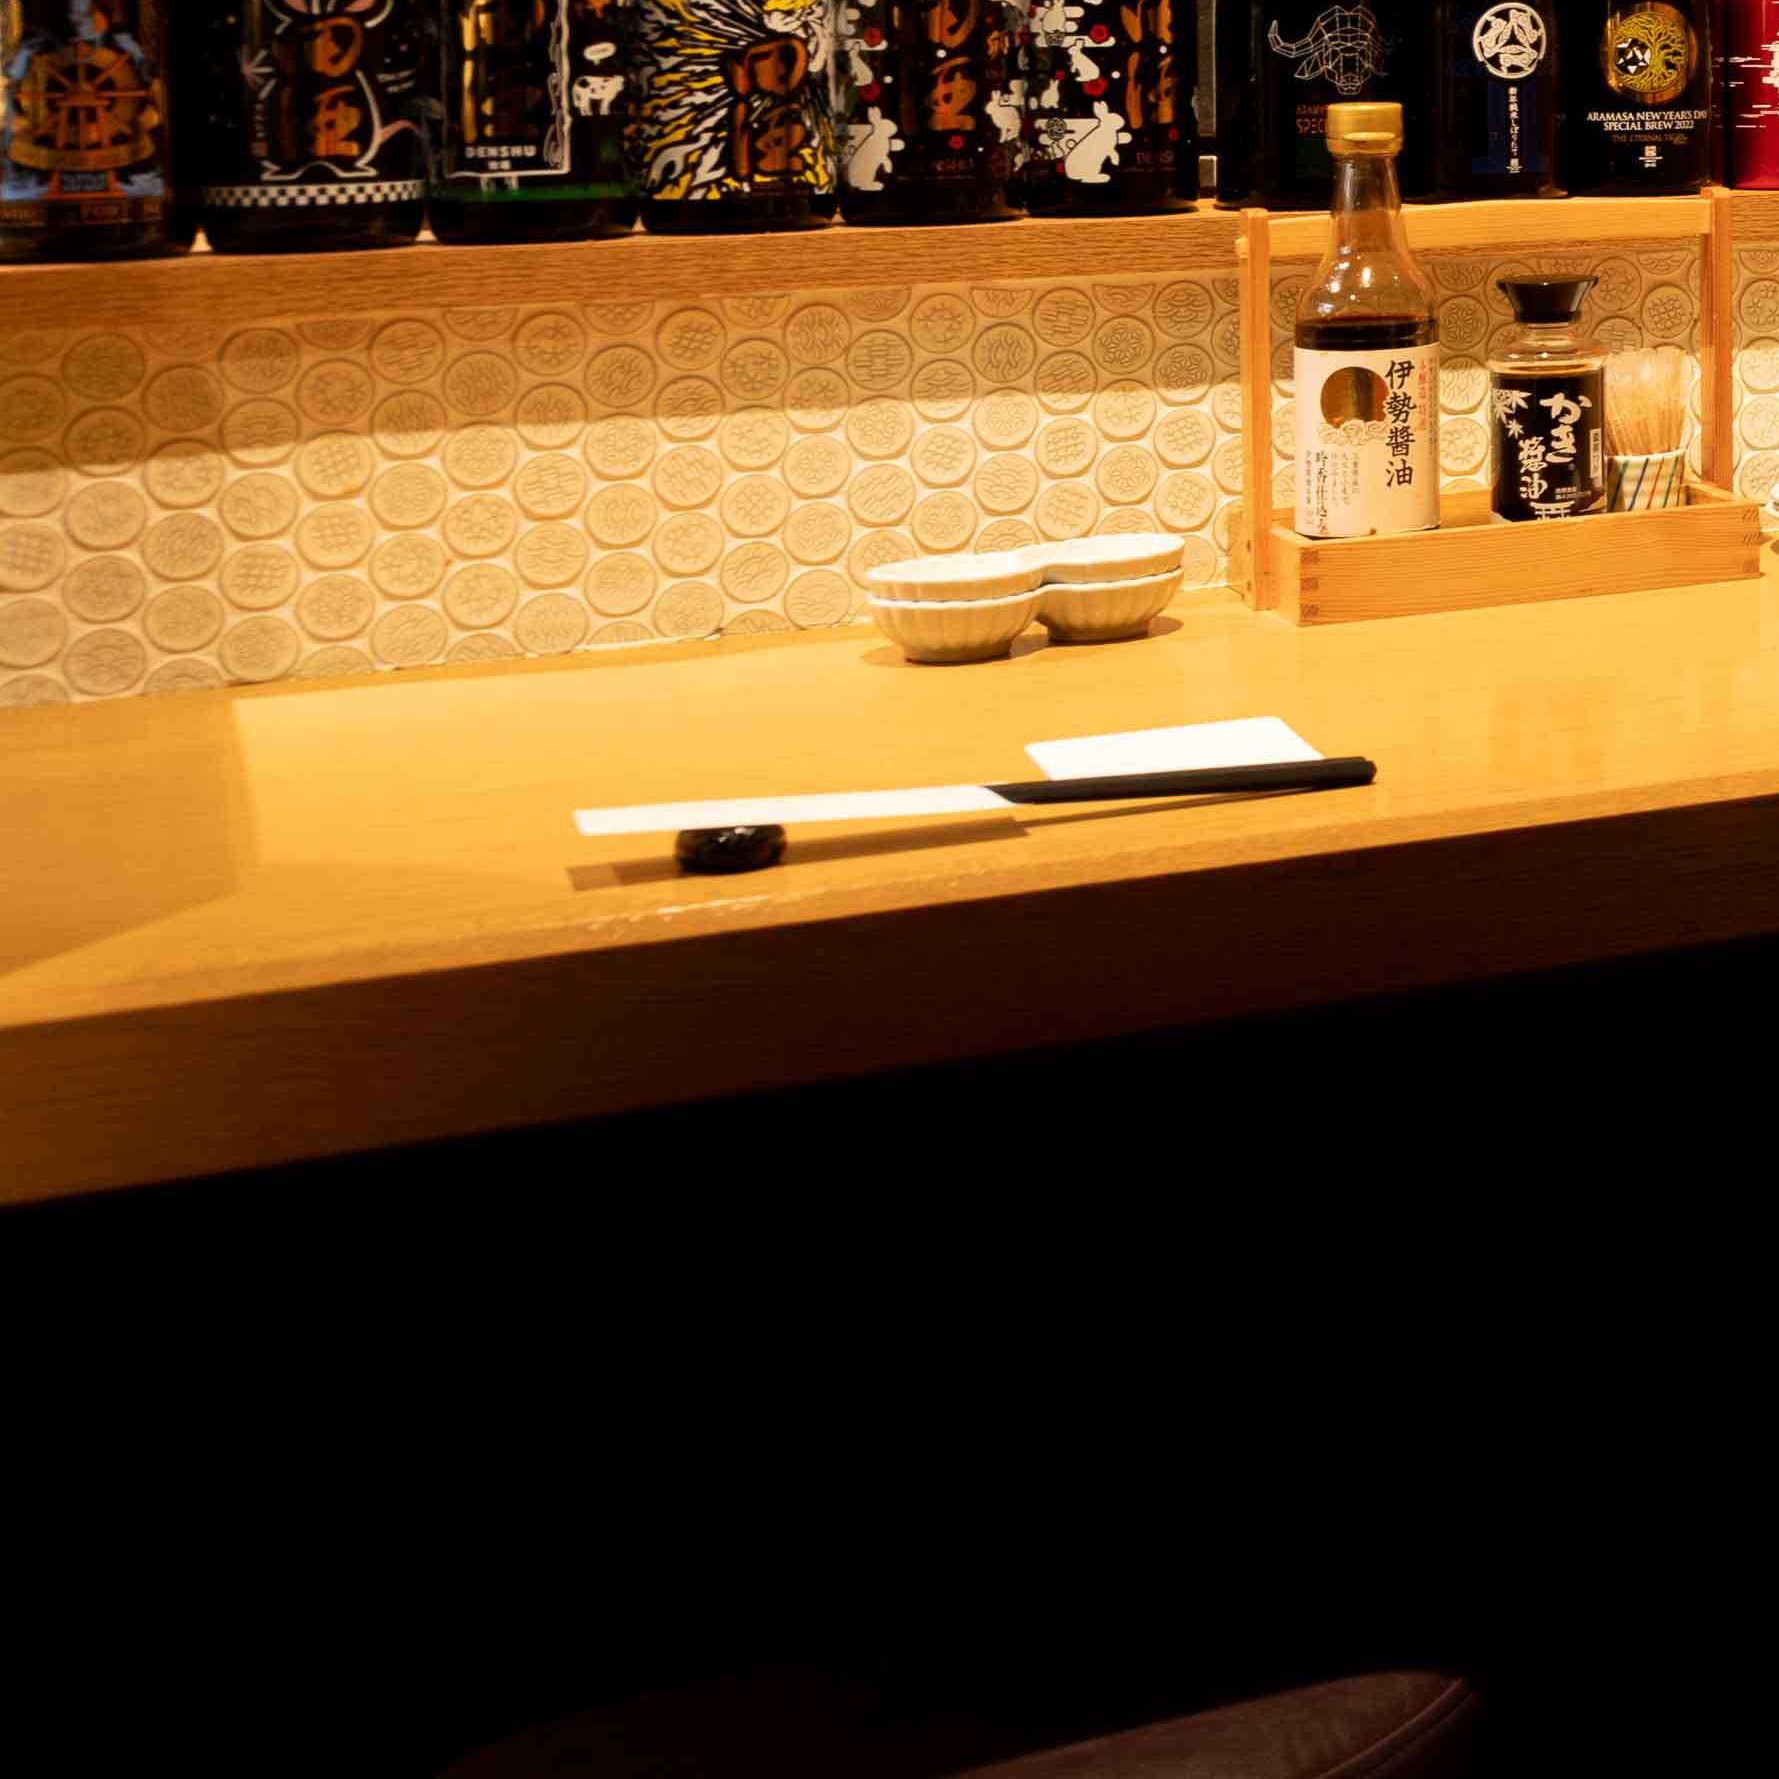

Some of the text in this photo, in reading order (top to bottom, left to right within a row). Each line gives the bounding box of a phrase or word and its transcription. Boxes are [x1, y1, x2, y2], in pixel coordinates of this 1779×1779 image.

[1586, 111, 1635, 122] ARAMASA
[1638, 111, 1660, 121] NEW
[1296, 117, 1327, 134] SPEC
[1603, 121, 1695, 131] SPECIAL BREW 2022
[1538, 392, 1592, 464] かき
